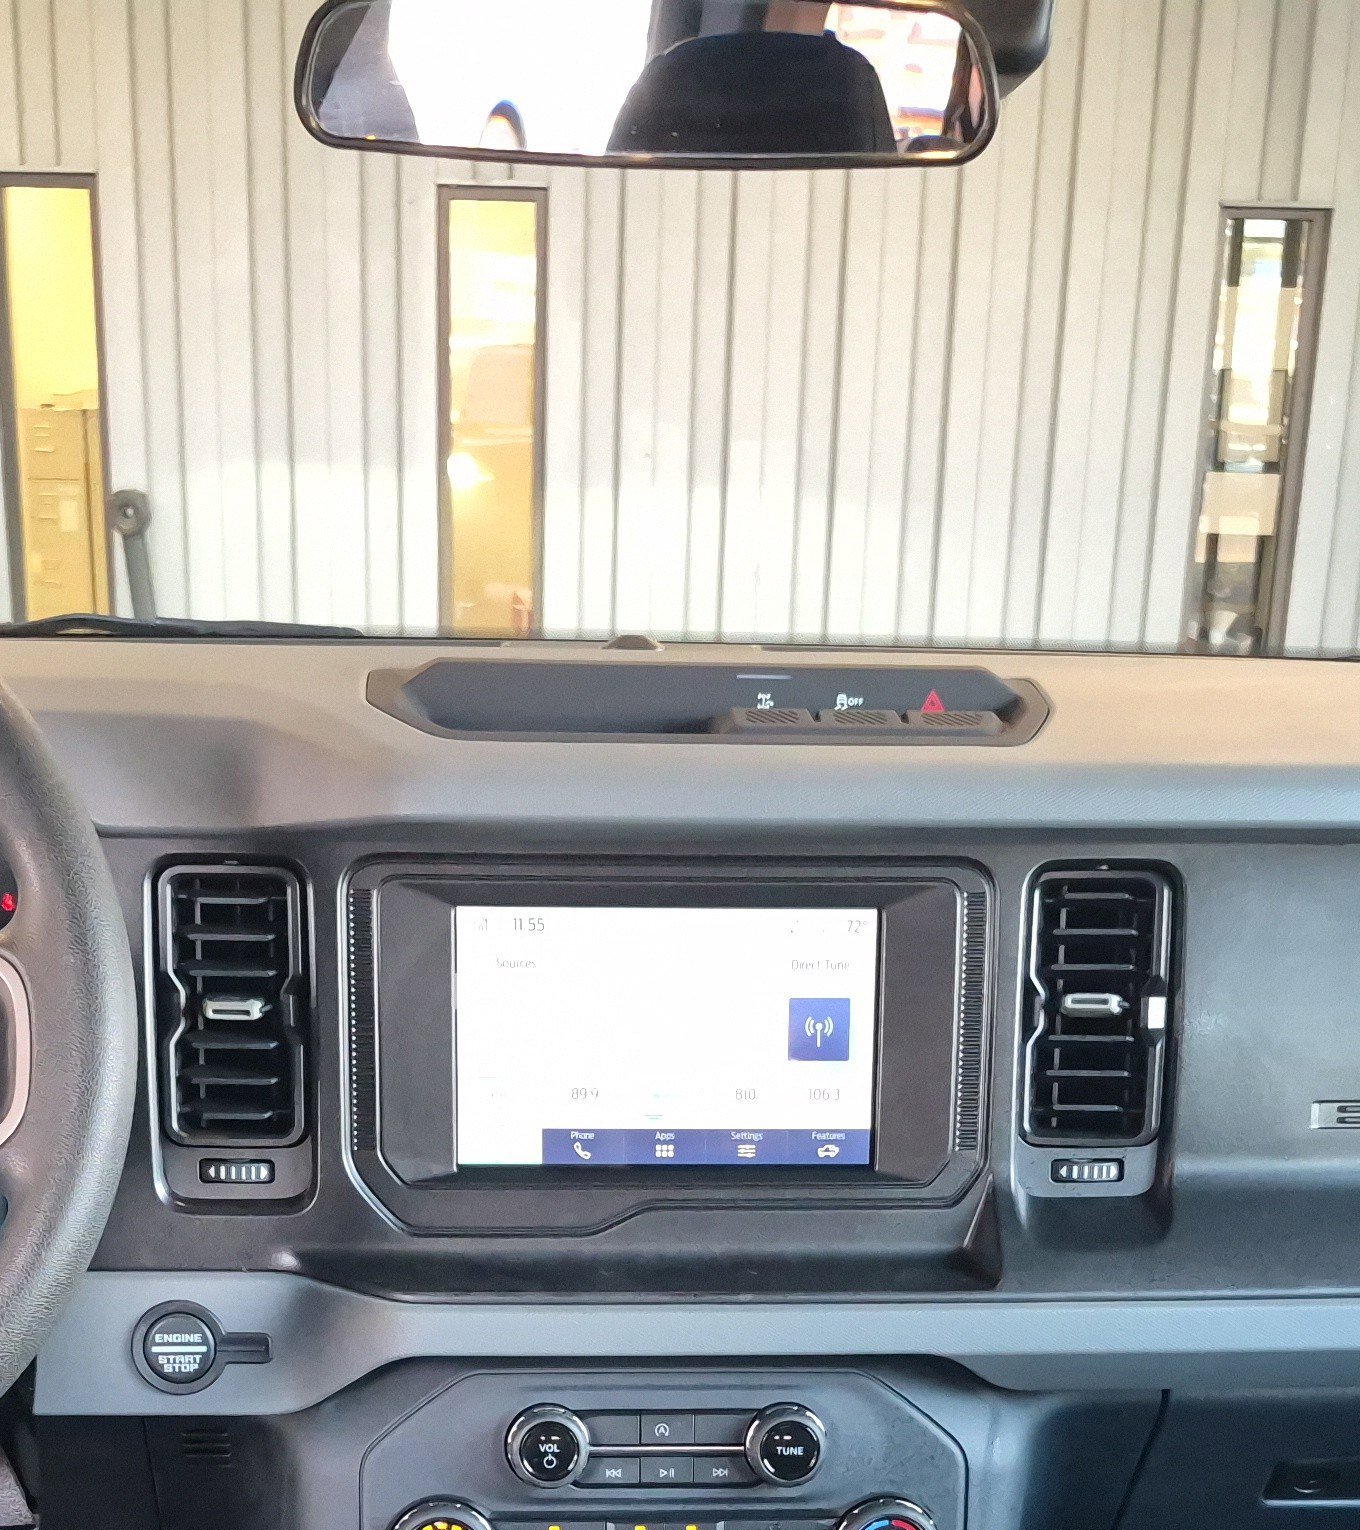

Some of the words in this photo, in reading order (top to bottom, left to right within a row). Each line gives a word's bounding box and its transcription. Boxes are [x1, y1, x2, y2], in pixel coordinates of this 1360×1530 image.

[847, 696, 864, 707] OFF
[513, 917, 545, 932] 1155
[496, 957, 537, 969] Sources
[825, 959, 850, 970] Tune
[571, 1087, 599, 1100] 899
[808, 1088, 840, 1101] 1063
[570, 1131, 595, 1140] Phone
[655, 1131, 675, 1141] Apps
[731, 1131, 763, 1141] Settings
[811, 1131, 846, 1140] Features
[154, 1333, 203, 1343] ENGINE
[157, 1354, 203, 1364] START
[163, 1363, 200, 1373] STOP
[538, 1443, 561, 1454] VOL
[776, 1446, 805, 1456] TUNE
